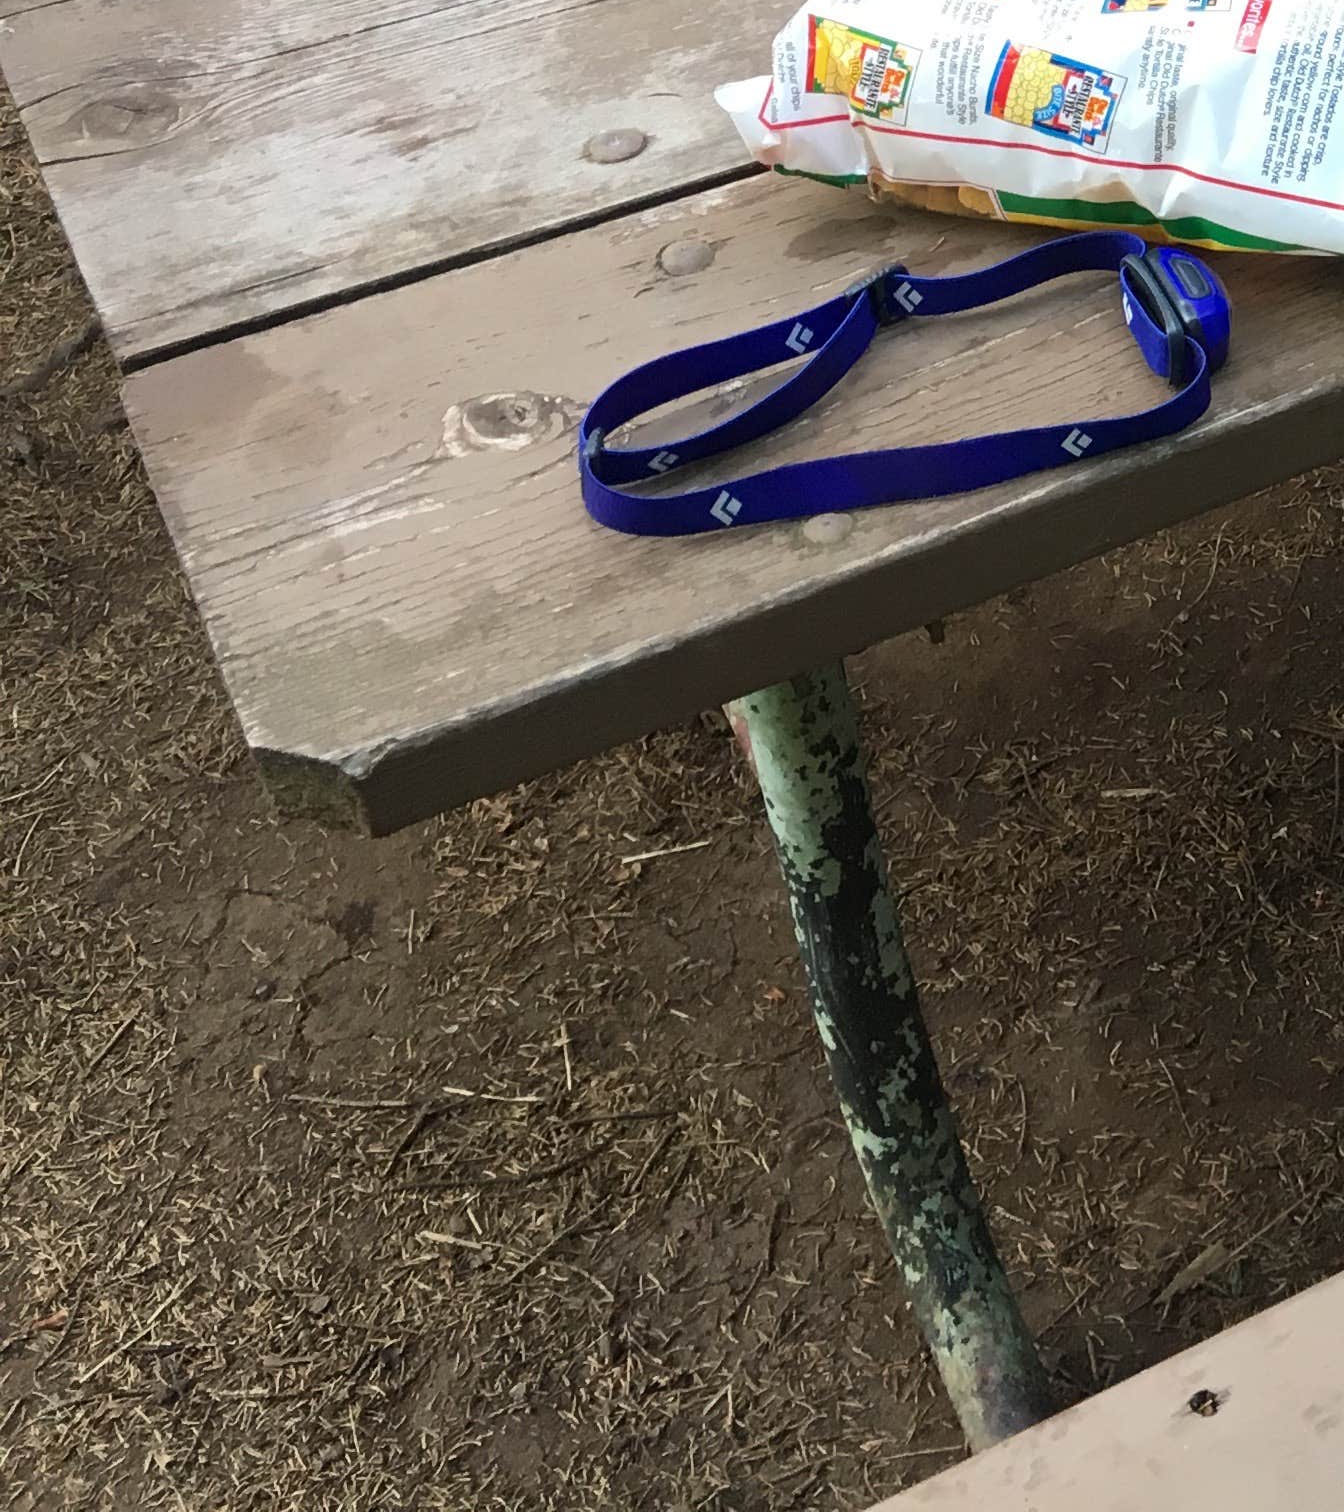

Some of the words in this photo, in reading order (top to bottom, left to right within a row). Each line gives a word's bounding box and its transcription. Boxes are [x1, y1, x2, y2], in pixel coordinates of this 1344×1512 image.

[940, 41, 951, 59] that
[972, 43, 985, 63] Size
[1314, 30, 1328, 58] ground
[787, 53, 797, 63] of
[1151, 50, 1163, 77] Tortilla
[1297, 58, 1309, 75] Old
[1322, 53, 1338, 86] perfect
[788, 64, 799, 85] your
[859, 63, 876, 89] STYLE
[864, 49, 891, 110] RESTAURANTE
[935, 60, 947, 104] wonderful
[957, 48, 972, 102] Restaurante
[969, 65, 981, 94] Nacho
[1162, 63, 1171, 78] Old
[1269, 67, 1283, 86] chip
[1306, 61, 1320, 91] yellow
[790, 87, 801, 111] chips
[1052, 87, 1063, 105] BITE
[1062, 88, 1078, 114] STYLE
[1146, 80, 1158, 105] Chips
[1300, 93, 1311, 113] corn
[1318, 88, 1330, 102] for
[1324, 85, 1343, 124] Tostados
[955, 103, 968, 125] Style
[1034, 106, 1058, 122] SIZE
[1071, 75, 1095, 135] RESTAURANTE
[1167, 90, 1179, 122] original
[1273, 106, 1285, 123] size
[1296, 115, 1307, 131] and
[1309, 103, 1324, 134] nachos
[1269, 125, 1280, 141] and
[1277, 109, 1297, 158] Restaurante
[1307, 136, 1316, 146] or
[1320, 125, 1332, 140] are
[1261, 144, 1276, 176] texture
[1286, 133, 1303, 168] cooked
[1270, 161, 1285, 185] Style
[1284, 170, 1294, 178] in
